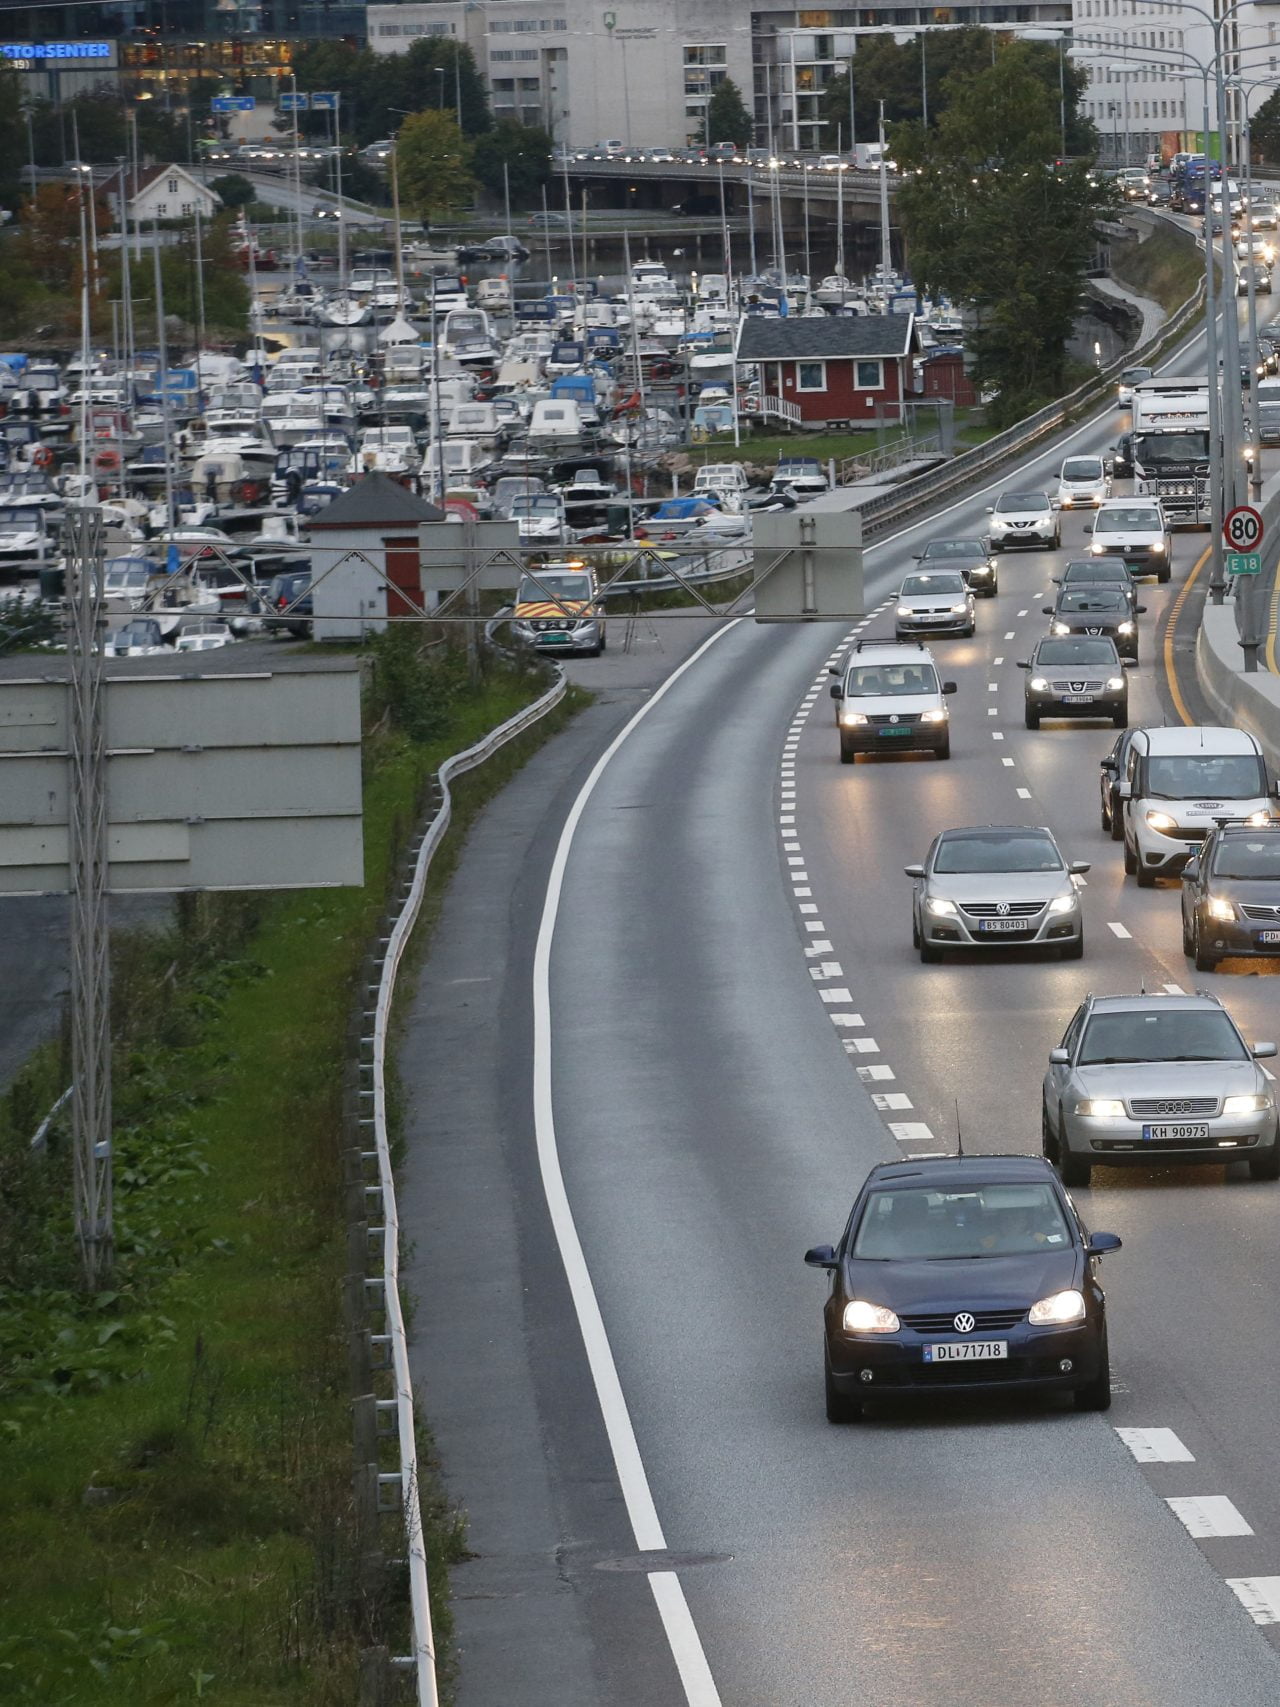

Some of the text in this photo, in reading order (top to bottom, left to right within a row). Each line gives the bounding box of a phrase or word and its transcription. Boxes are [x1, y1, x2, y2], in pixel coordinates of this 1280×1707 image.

[1232, 518, 1258, 540] 80
[1232, 558, 1257, 570] E 18
[1000, 921, 1025, 929] 80403
[1265, 932, 1276, 940] PD
[1152, 1126, 1206, 1138] KH 90975
[938, 1343, 1001, 1359] DL 71718
